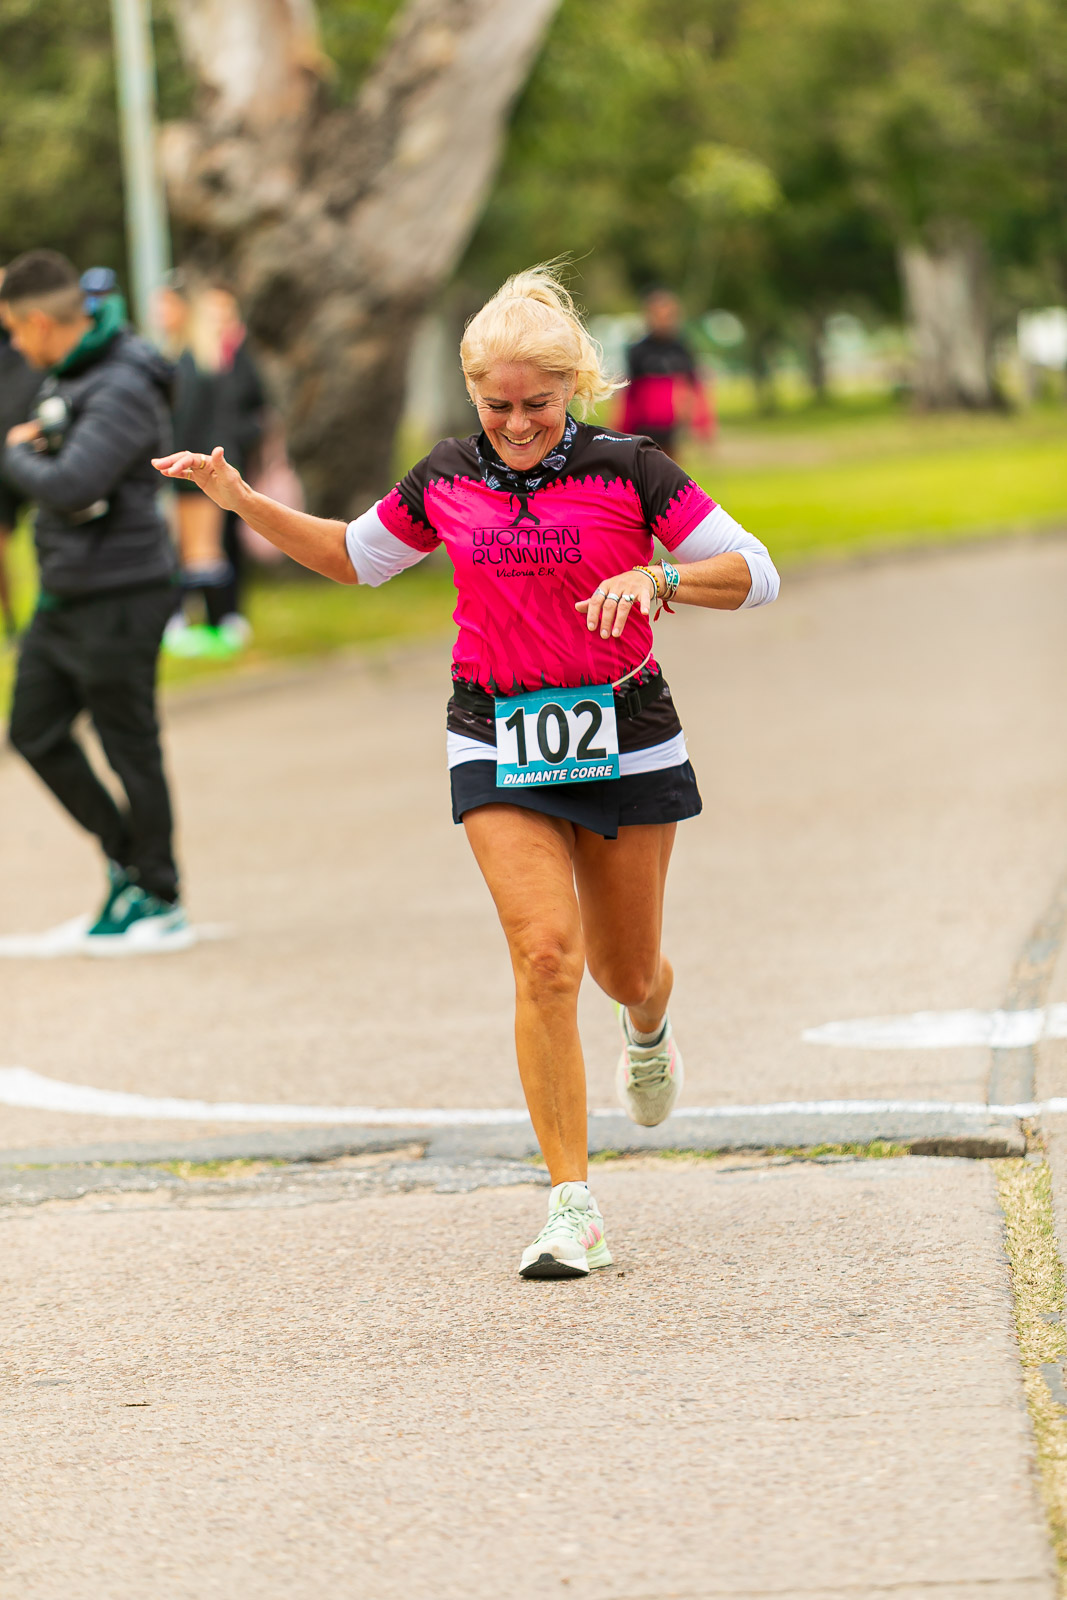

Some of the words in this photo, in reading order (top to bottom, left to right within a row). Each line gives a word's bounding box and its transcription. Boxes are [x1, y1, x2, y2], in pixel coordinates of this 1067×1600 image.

[472, 528, 580, 547] WOMAN
[472, 547, 582, 566] RUNNING
[496, 567, 536, 578] Victoria
[504, 699, 608, 768] 102
[503, 769, 568, 785] DIAMANTE
[570, 765, 613, 779] CORRE
